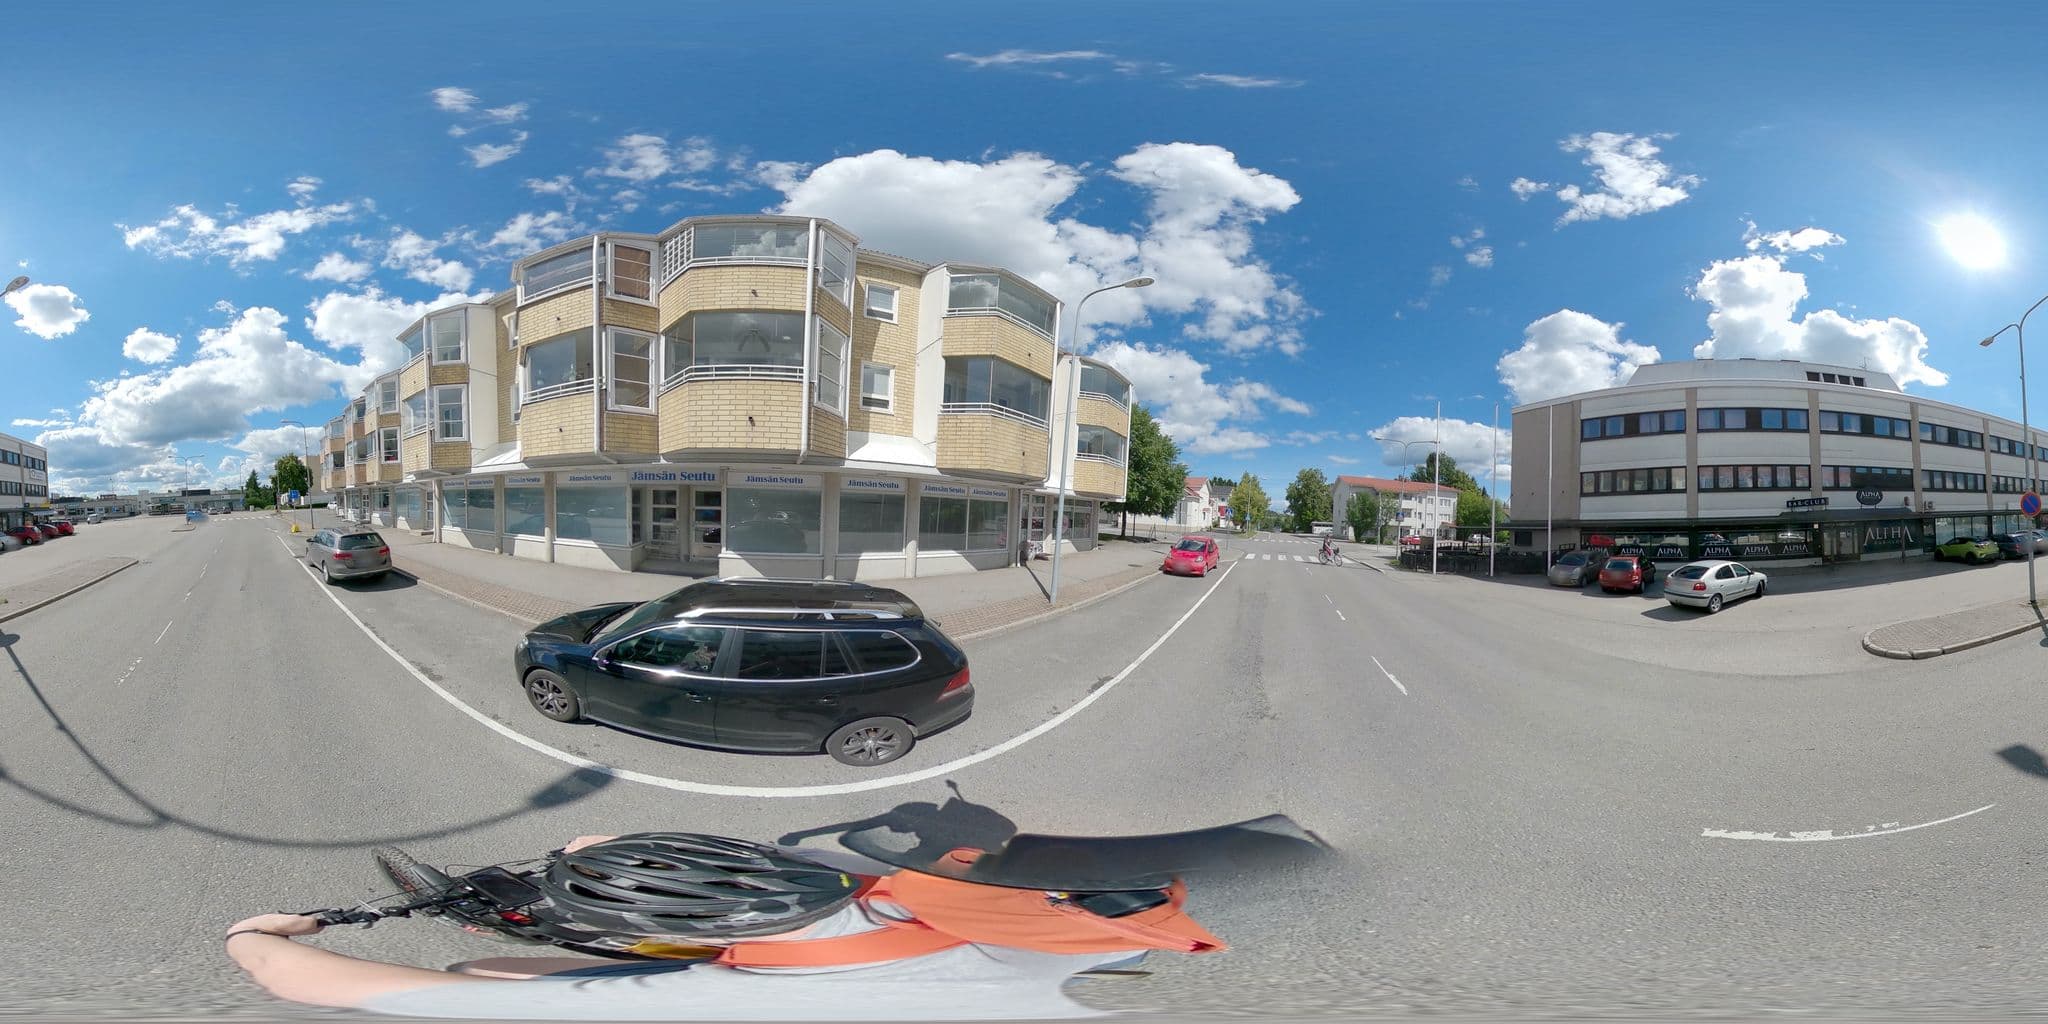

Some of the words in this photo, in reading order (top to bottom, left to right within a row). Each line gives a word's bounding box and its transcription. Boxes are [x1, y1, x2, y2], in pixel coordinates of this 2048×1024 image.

[632, 470, 676, 481] Jämsän
[680, 472, 716, 481] Seutu
[745, 475, 778, 483] Jämsän
[780, 476, 803, 484] Seutu
[848, 479, 877, 487] Jämsän
[878, 481, 899, 489] Seutu
[924, 484, 948, 492] Jämsän
[1860, 491, 1880, 499] ALPHA
[1620, 547, 1645, 556] ALPHA
[1657, 547, 1683, 556] ALPHA
[1704, 547, 1732, 556] ALPHA
[1743, 546, 1771, 555] ALPHA
[1782, 544, 1809, 554] ALPHA
